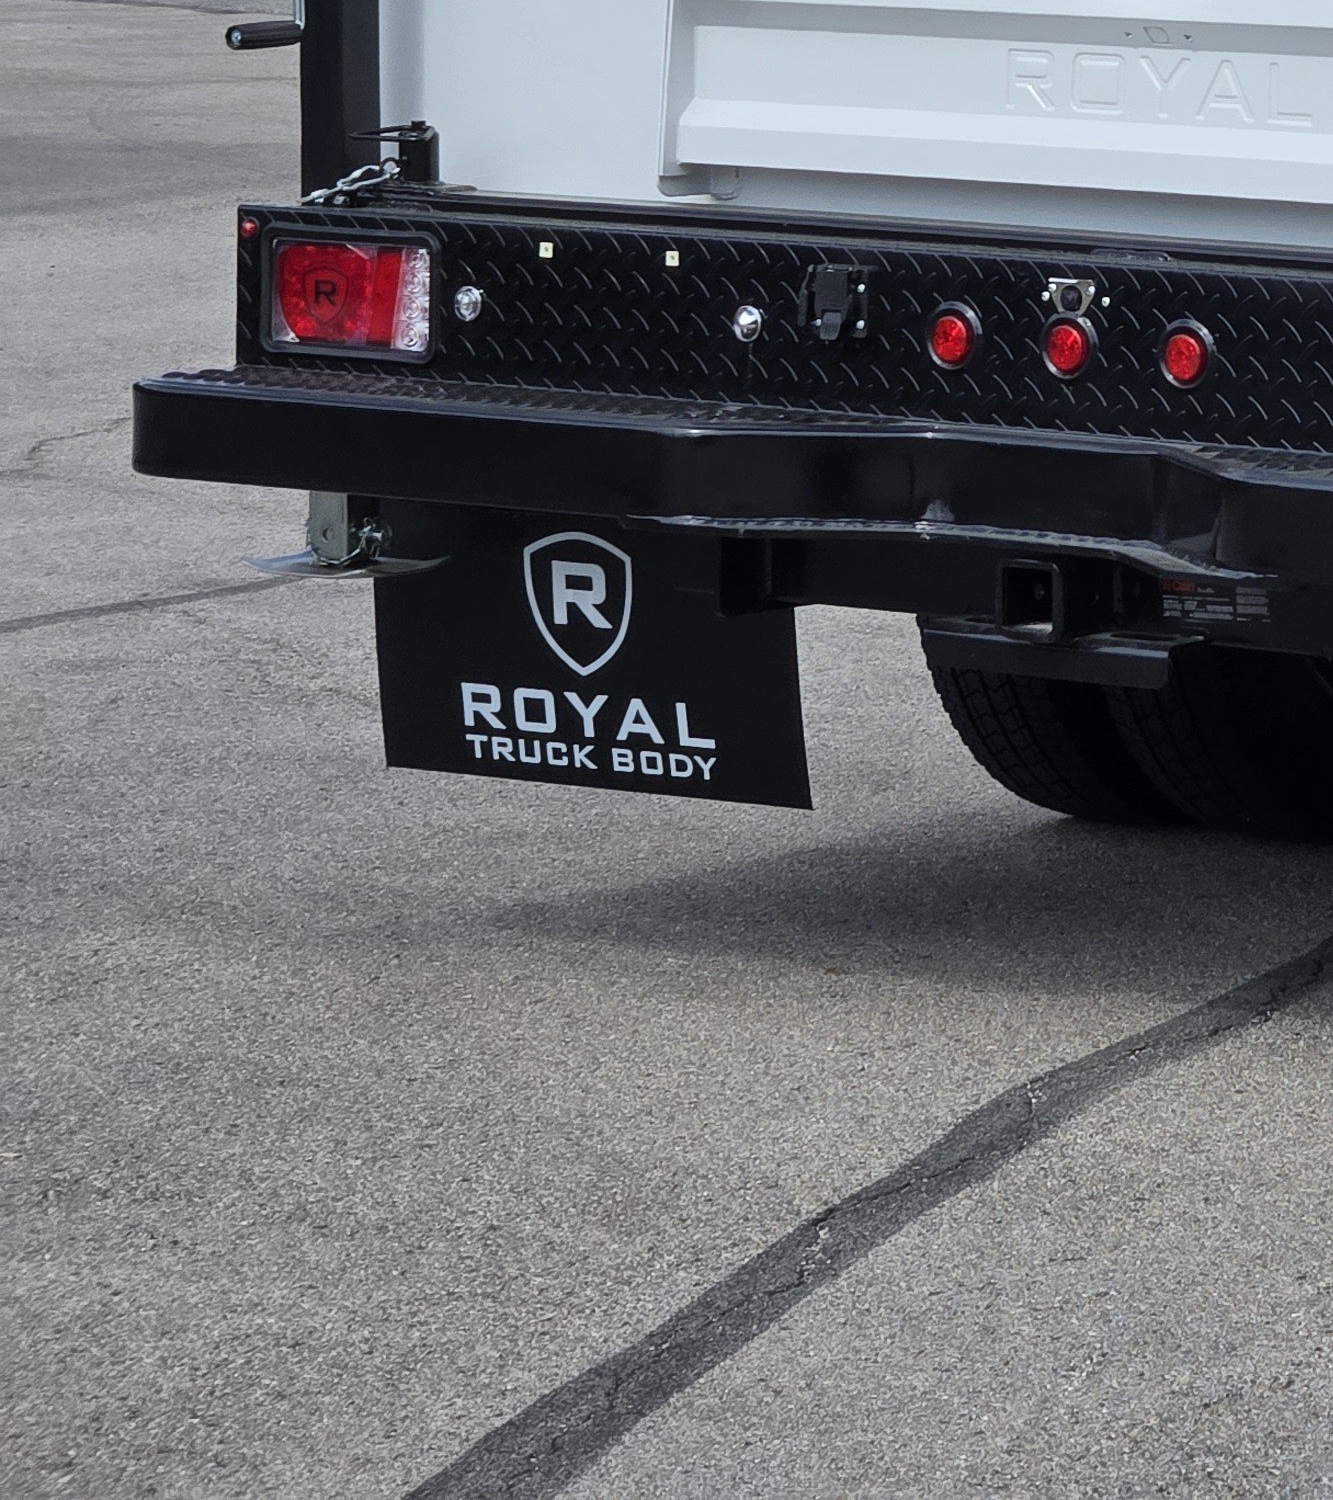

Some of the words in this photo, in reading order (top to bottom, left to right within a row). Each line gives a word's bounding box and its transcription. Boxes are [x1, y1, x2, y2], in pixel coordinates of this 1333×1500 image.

[1006, 48, 1313, 127] ROYAL
[314, 279, 337, 307] R
[551, 559, 613, 629] R
[460, 682, 716, 750] ROYAL
[465, 733, 599, 770] TRUCK
[611, 747, 717, 781] BODY
